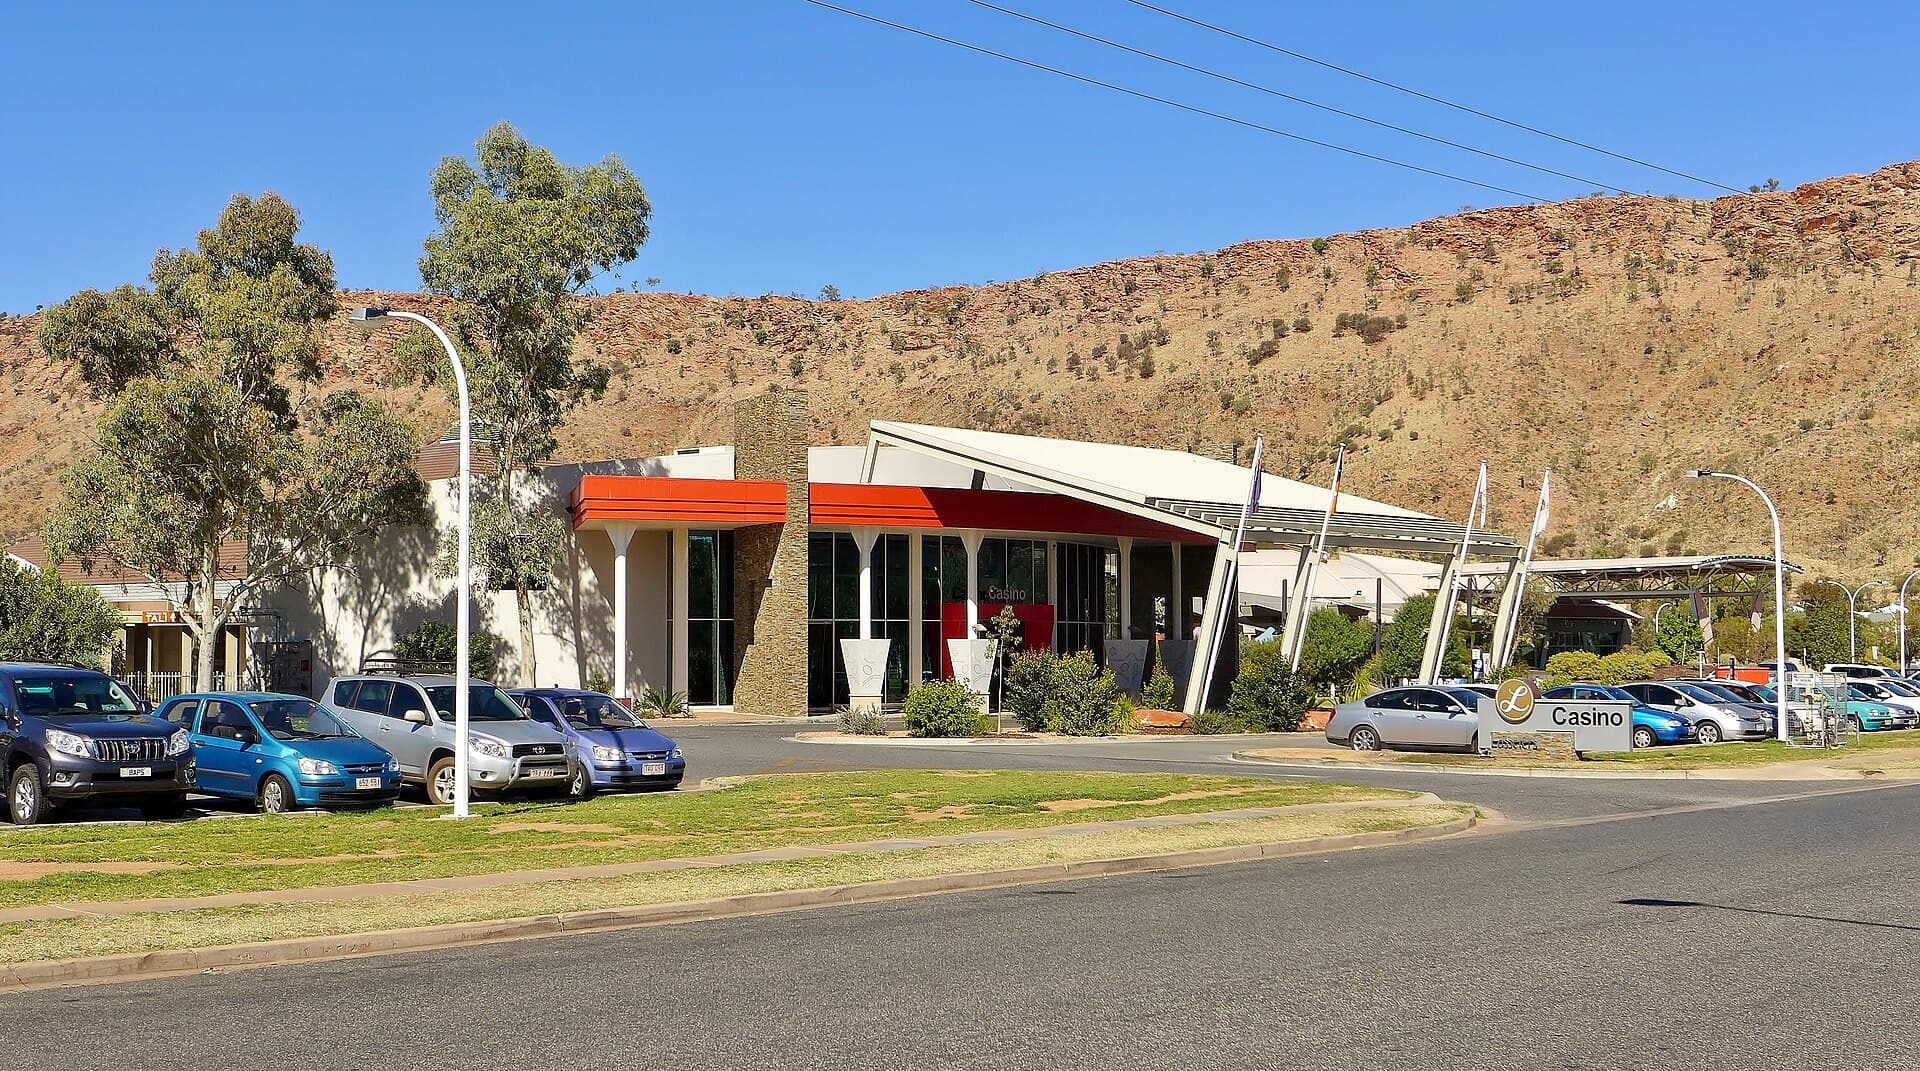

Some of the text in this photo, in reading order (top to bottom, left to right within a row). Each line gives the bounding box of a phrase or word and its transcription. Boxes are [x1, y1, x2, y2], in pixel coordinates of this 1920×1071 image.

[988, 585, 1026, 600] Casino
[1499, 685, 1531, 713] L
[1552, 706, 1623, 726] Casino
